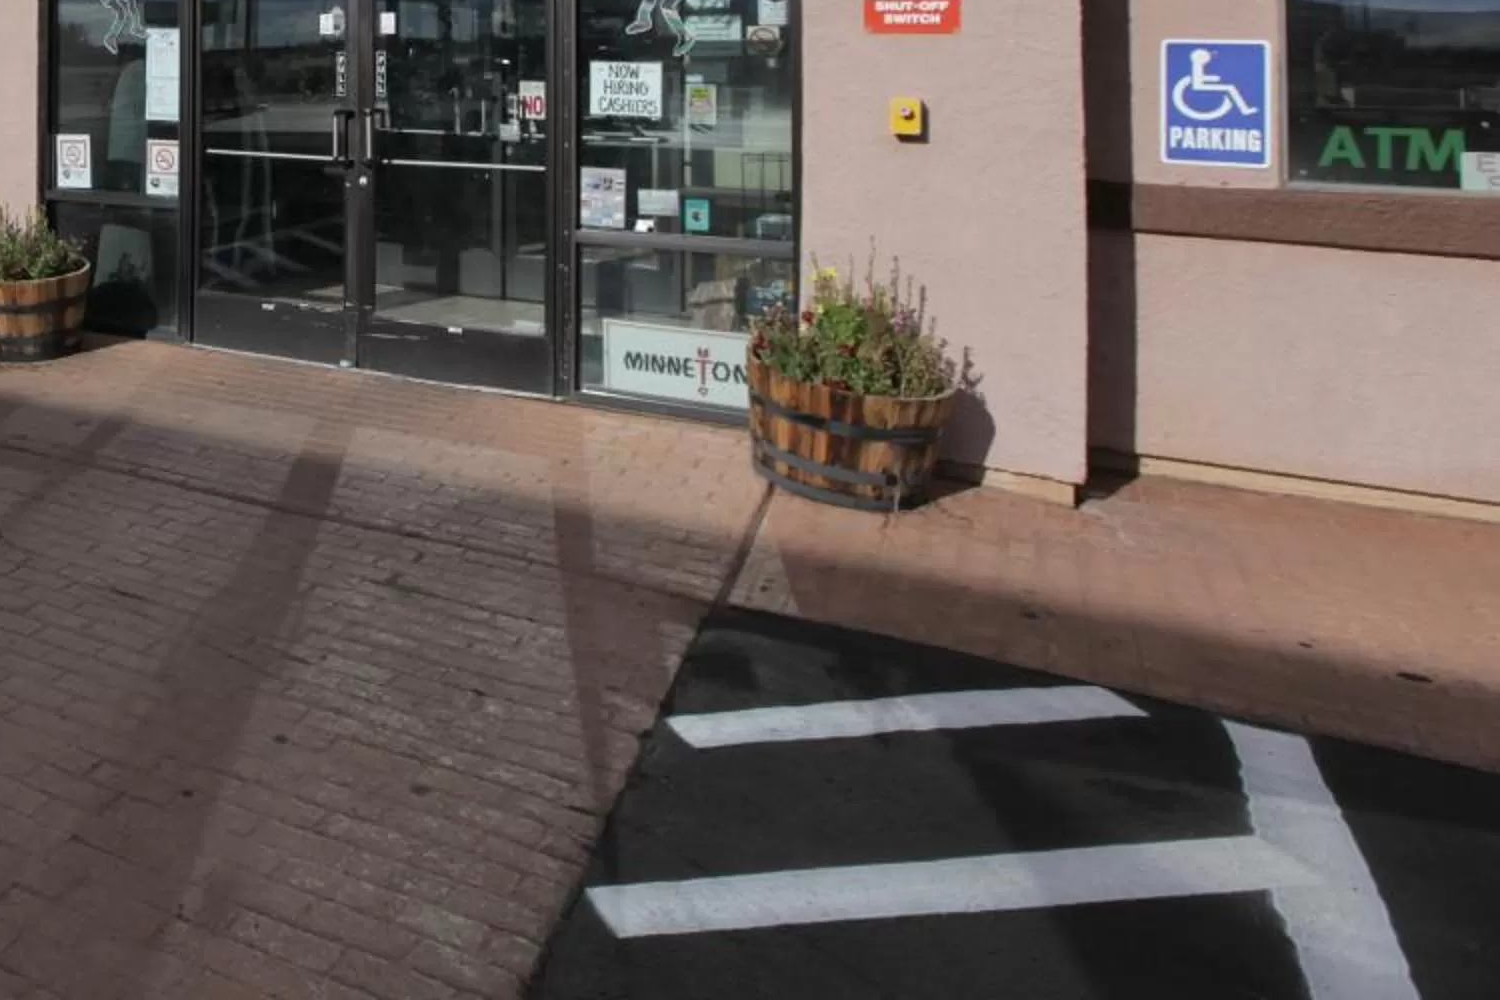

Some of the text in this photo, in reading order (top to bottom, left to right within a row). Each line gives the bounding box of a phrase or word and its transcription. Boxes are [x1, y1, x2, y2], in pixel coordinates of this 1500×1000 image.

[608, 64, 641, 78] NOW
[603, 79, 649, 96] HIRING
[599, 96, 657, 115] CASHIERS
[1169, 125, 1262, 152] PARKING
[1318, 125, 1466, 172] ATM
